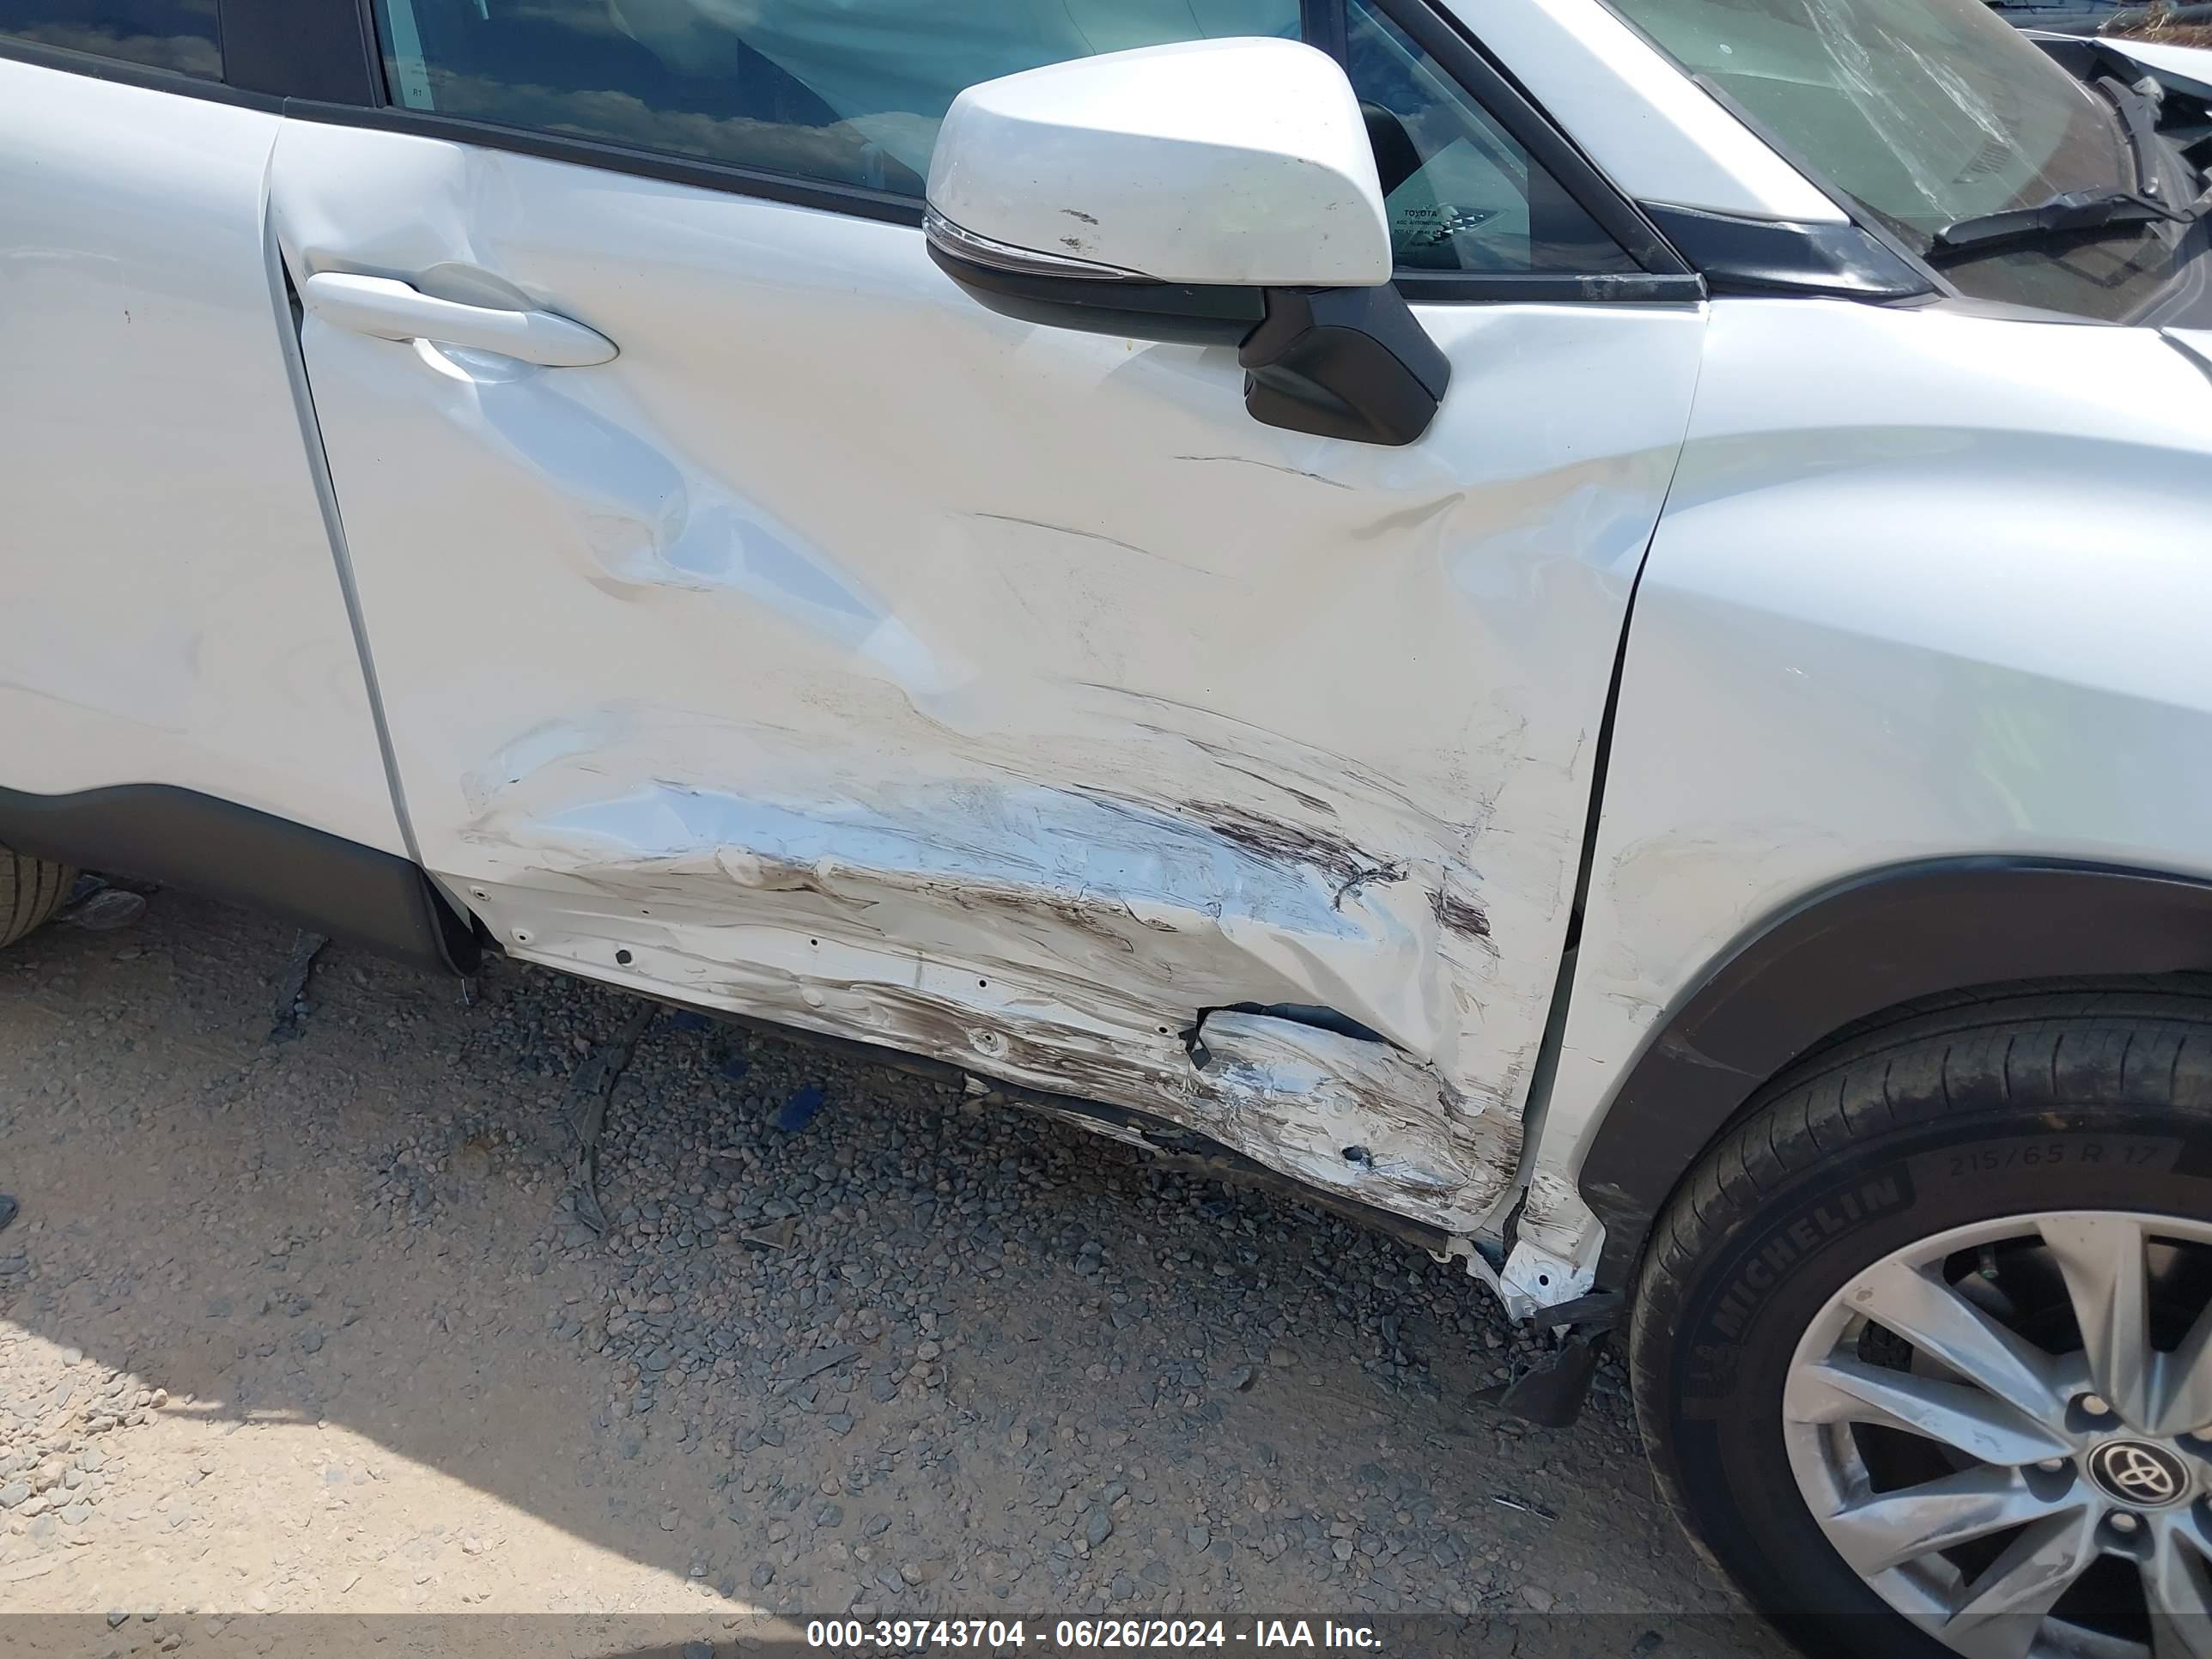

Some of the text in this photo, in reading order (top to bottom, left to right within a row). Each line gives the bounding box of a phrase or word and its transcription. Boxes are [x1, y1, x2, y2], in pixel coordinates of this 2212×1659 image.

[1404, 210, 1437, 218] TOYOTA
[1949, 1143, 2160, 1177] 215/65 R 17
[1711, 1176, 1900, 1338] MICHELIN
